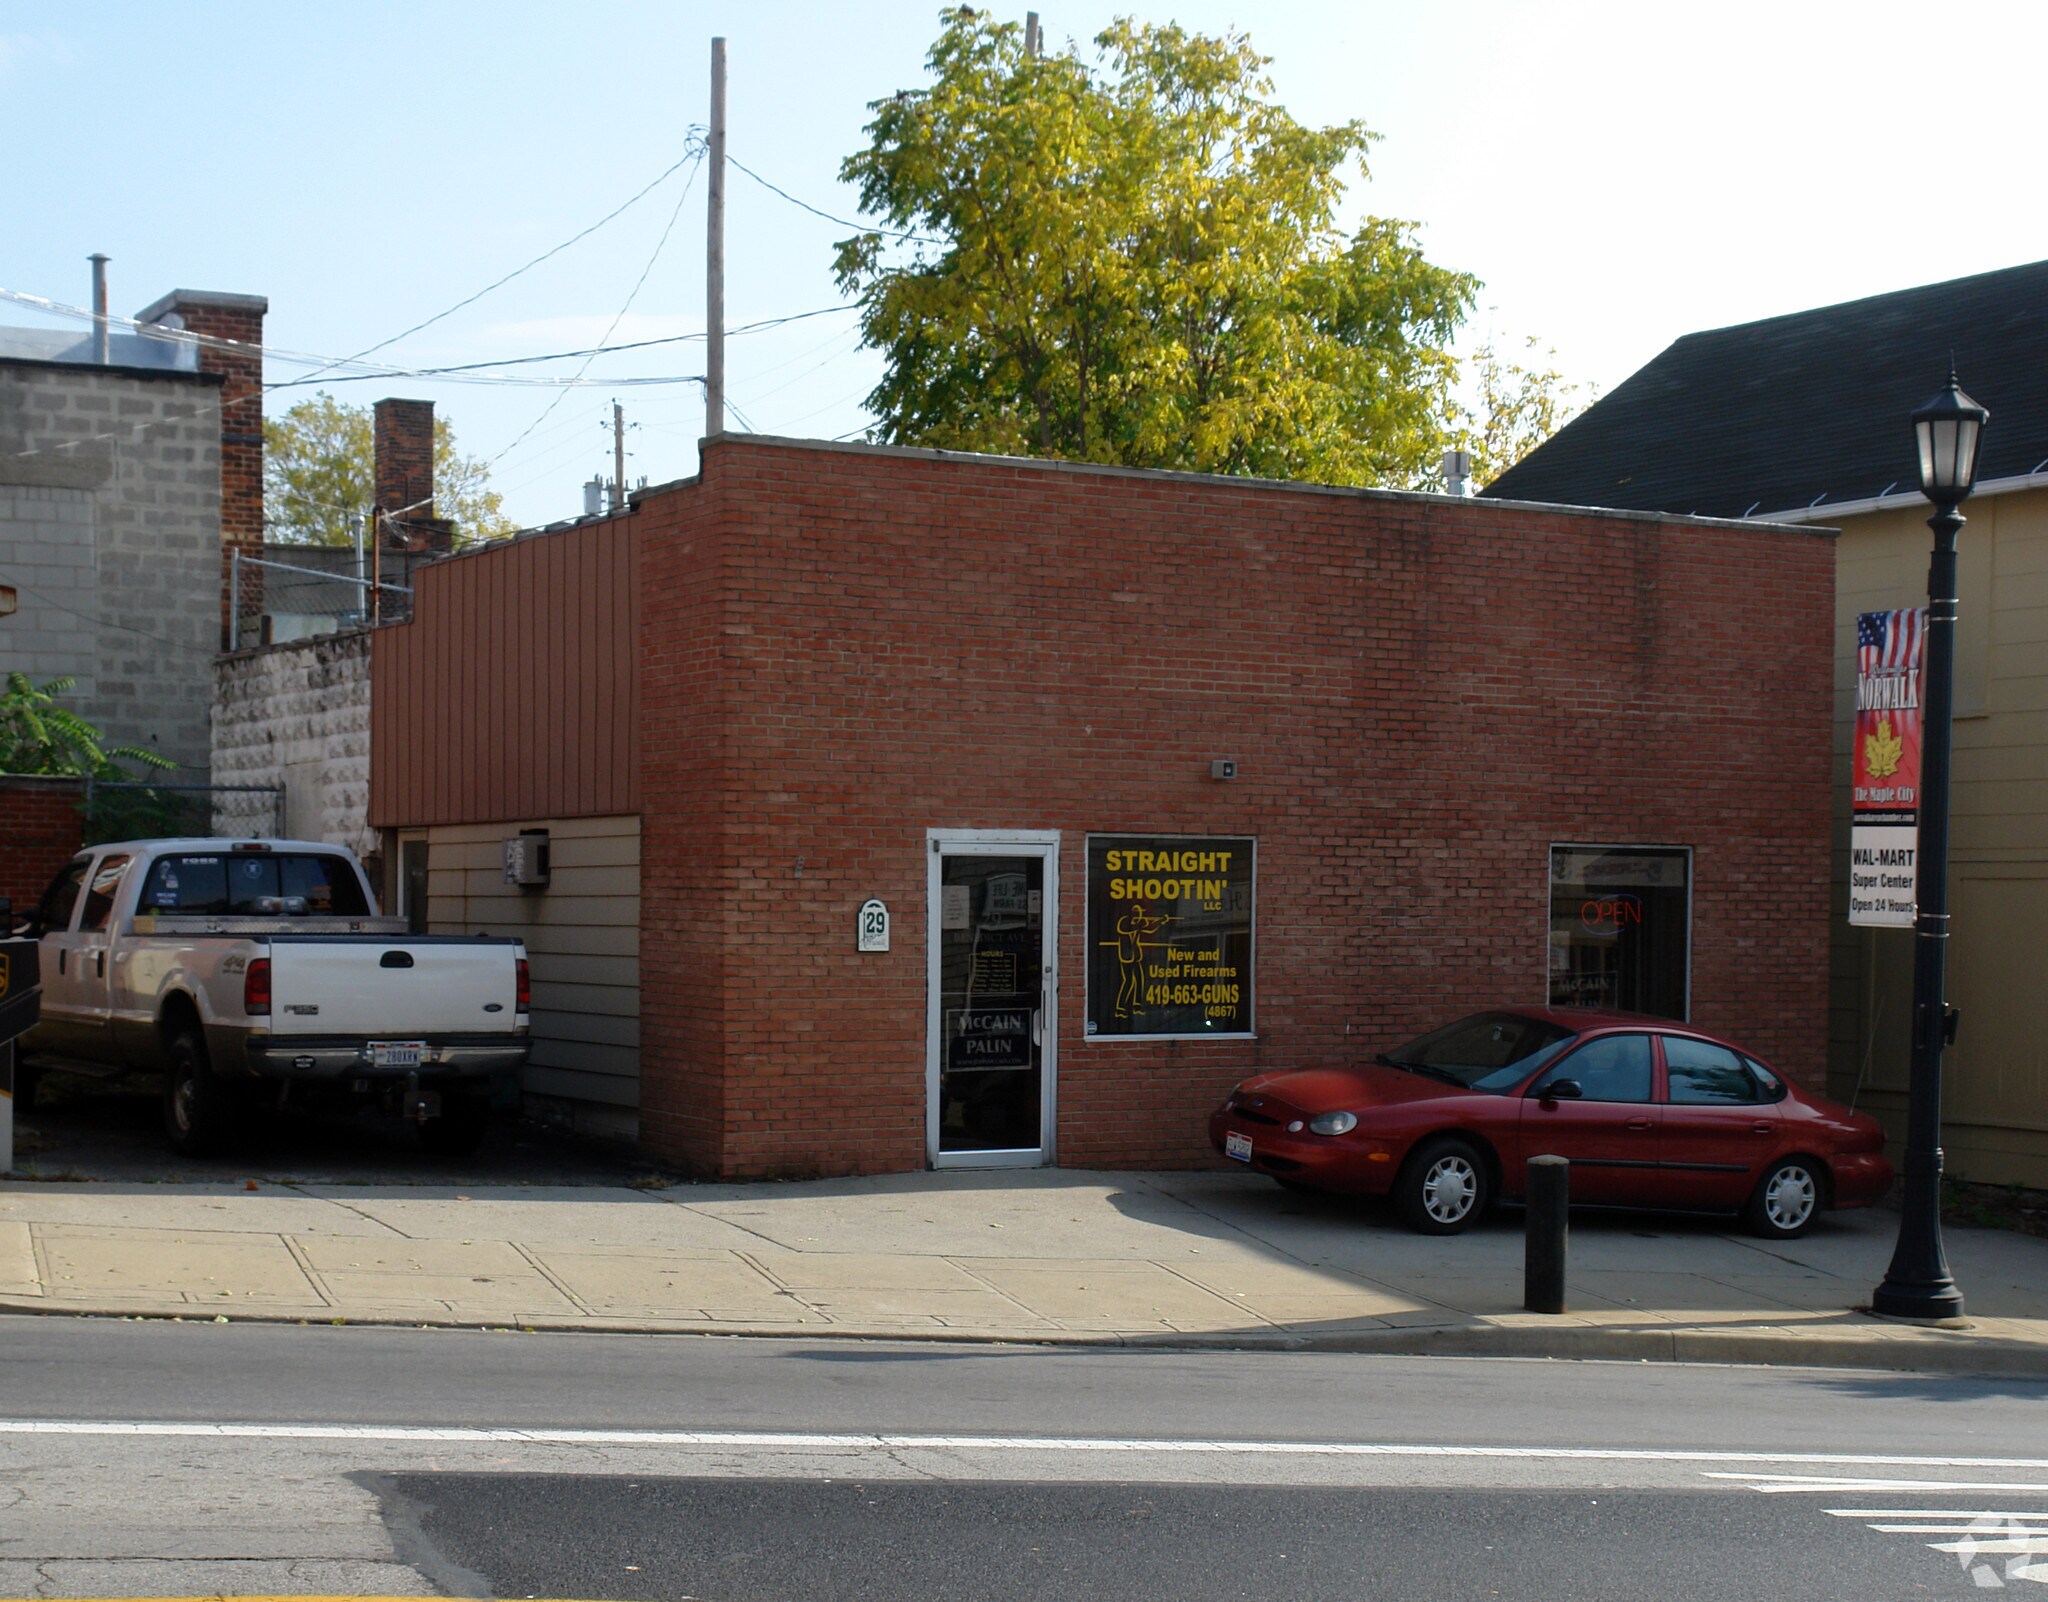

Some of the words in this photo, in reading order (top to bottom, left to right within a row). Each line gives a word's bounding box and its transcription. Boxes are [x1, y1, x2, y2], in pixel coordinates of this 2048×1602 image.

[1857, 669, 1919, 711] NORWALK
[1855, 787, 1868, 801] The
[1869, 787, 1895, 803] Maple
[1897, 786, 1915, 803] City
[182, 857, 218, 865] FORD
[1106, 850, 1232, 872] STRAIGHT
[1853, 849, 1914, 866] WAL-MART
[1110, 878, 1227, 900] SHOOTIN'
[1853, 873, 1877, 890] Super
[1881, 873, 1914, 888] Center
[1203, 902, 1222, 911] LLC
[1581, 901, 1641, 925] OPEN
[1852, 898, 1873, 913] Open
[1875, 899, 1886, 911] 24
[1888, 900, 1914, 912] Hours
[866, 912, 885, 933] 29
[1167, 948, 1194, 961] New
[1197, 948, 1220, 961] and
[1149, 965, 1180, 978] Used
[1183, 964, 1237, 978] Firearms
[1146, 984, 1239, 1005] 419-663-GUNS
[1204, 1005, 1236, 1020] (4867)
[958, 1015, 1021, 1030] McCAIN
[966, 1039, 1012, 1054] PALIN
